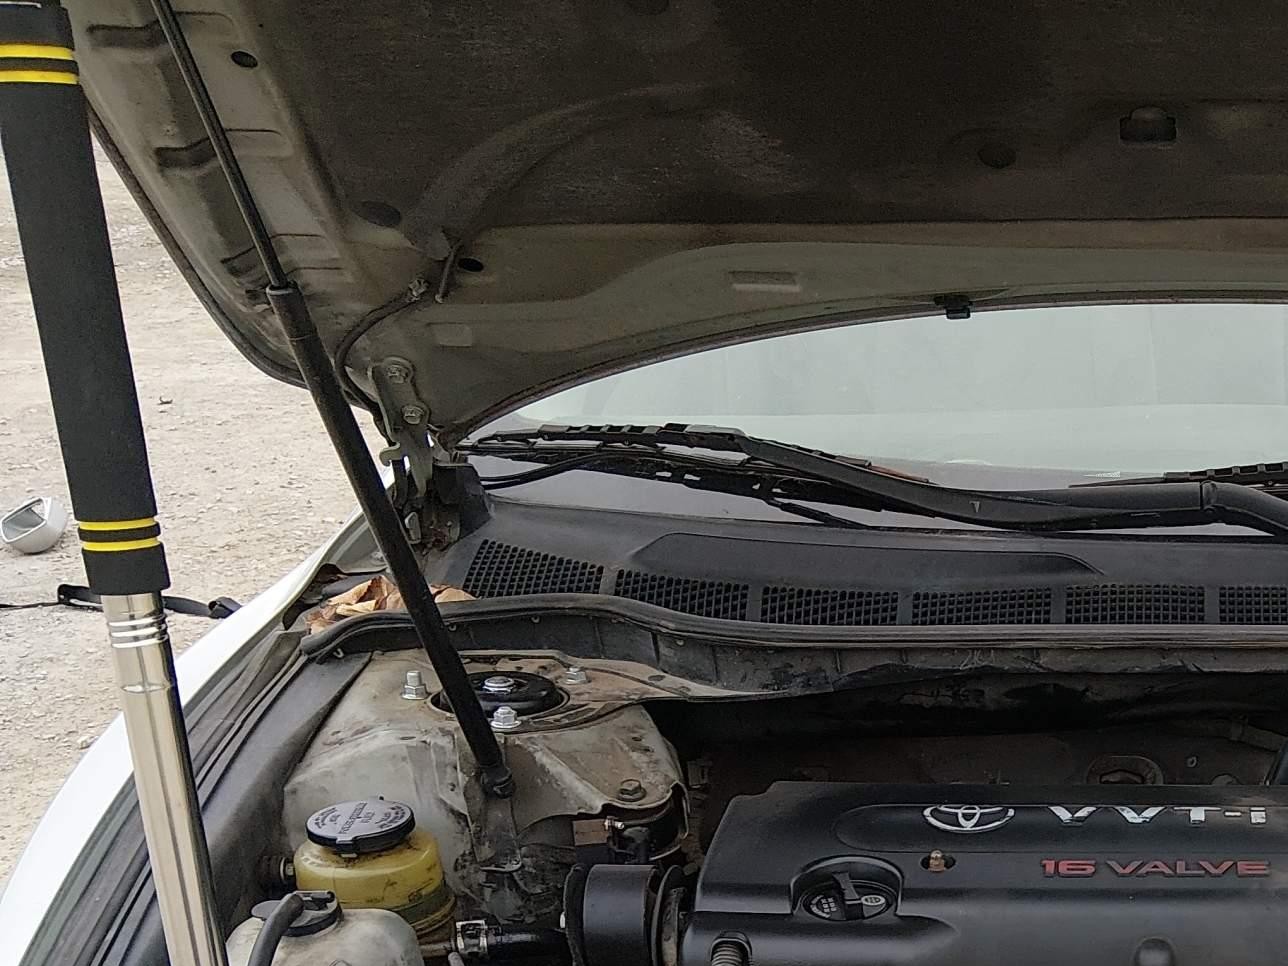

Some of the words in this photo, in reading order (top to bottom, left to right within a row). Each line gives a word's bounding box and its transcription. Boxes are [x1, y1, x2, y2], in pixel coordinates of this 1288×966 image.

[1047, 806, 1268, 825] VVT-i
[1041, 860, 1097, 877] 16
[1106, 860, 1270, 877] VALVE
